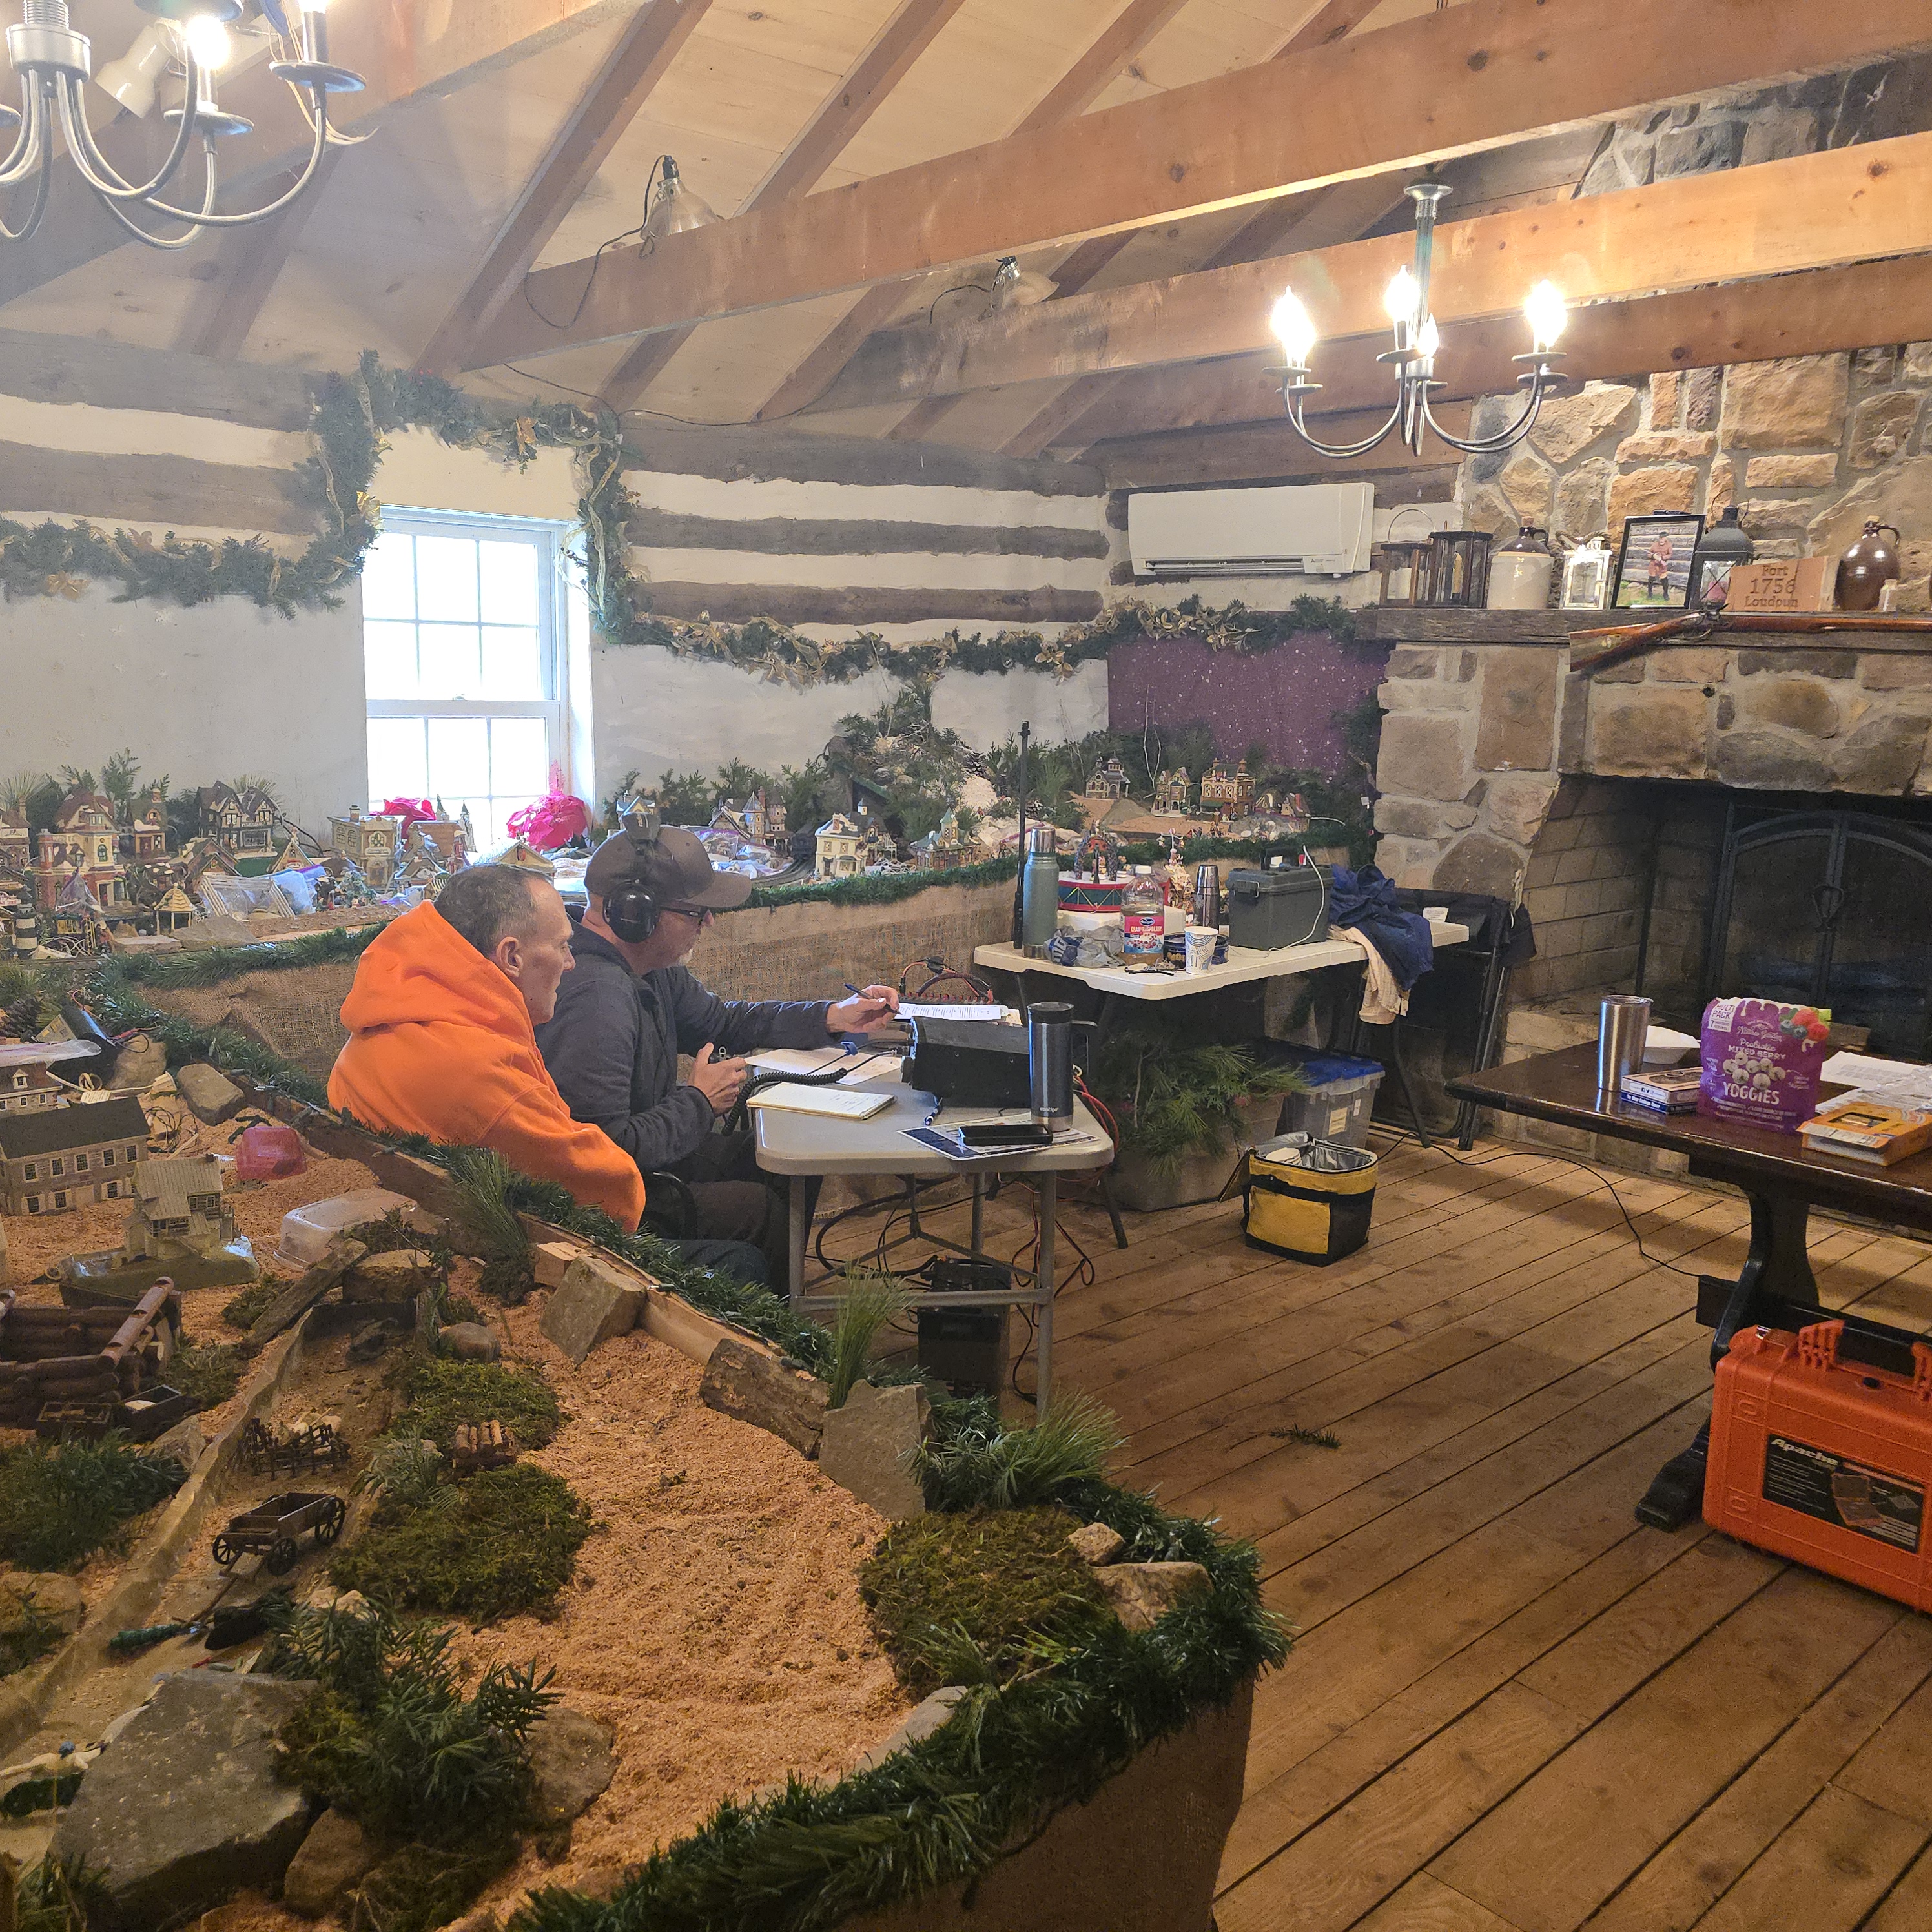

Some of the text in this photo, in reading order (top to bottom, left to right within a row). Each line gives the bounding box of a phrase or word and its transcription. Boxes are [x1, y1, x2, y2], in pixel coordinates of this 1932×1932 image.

[1762, 565, 1789, 576] Fort
[1750, 579, 1796, 595] 1756
[1744, 596, 1799, 608] Loudoun
[1712, 1010, 1732, 1020] PACK
[1740, 1038, 1776, 1052] Probiotic
[1728, 1045, 1786, 1060] MIXED BERRY
[1723, 1081, 1780, 1105] YOGGIES
[1771, 1438, 1839, 1466] Apache
